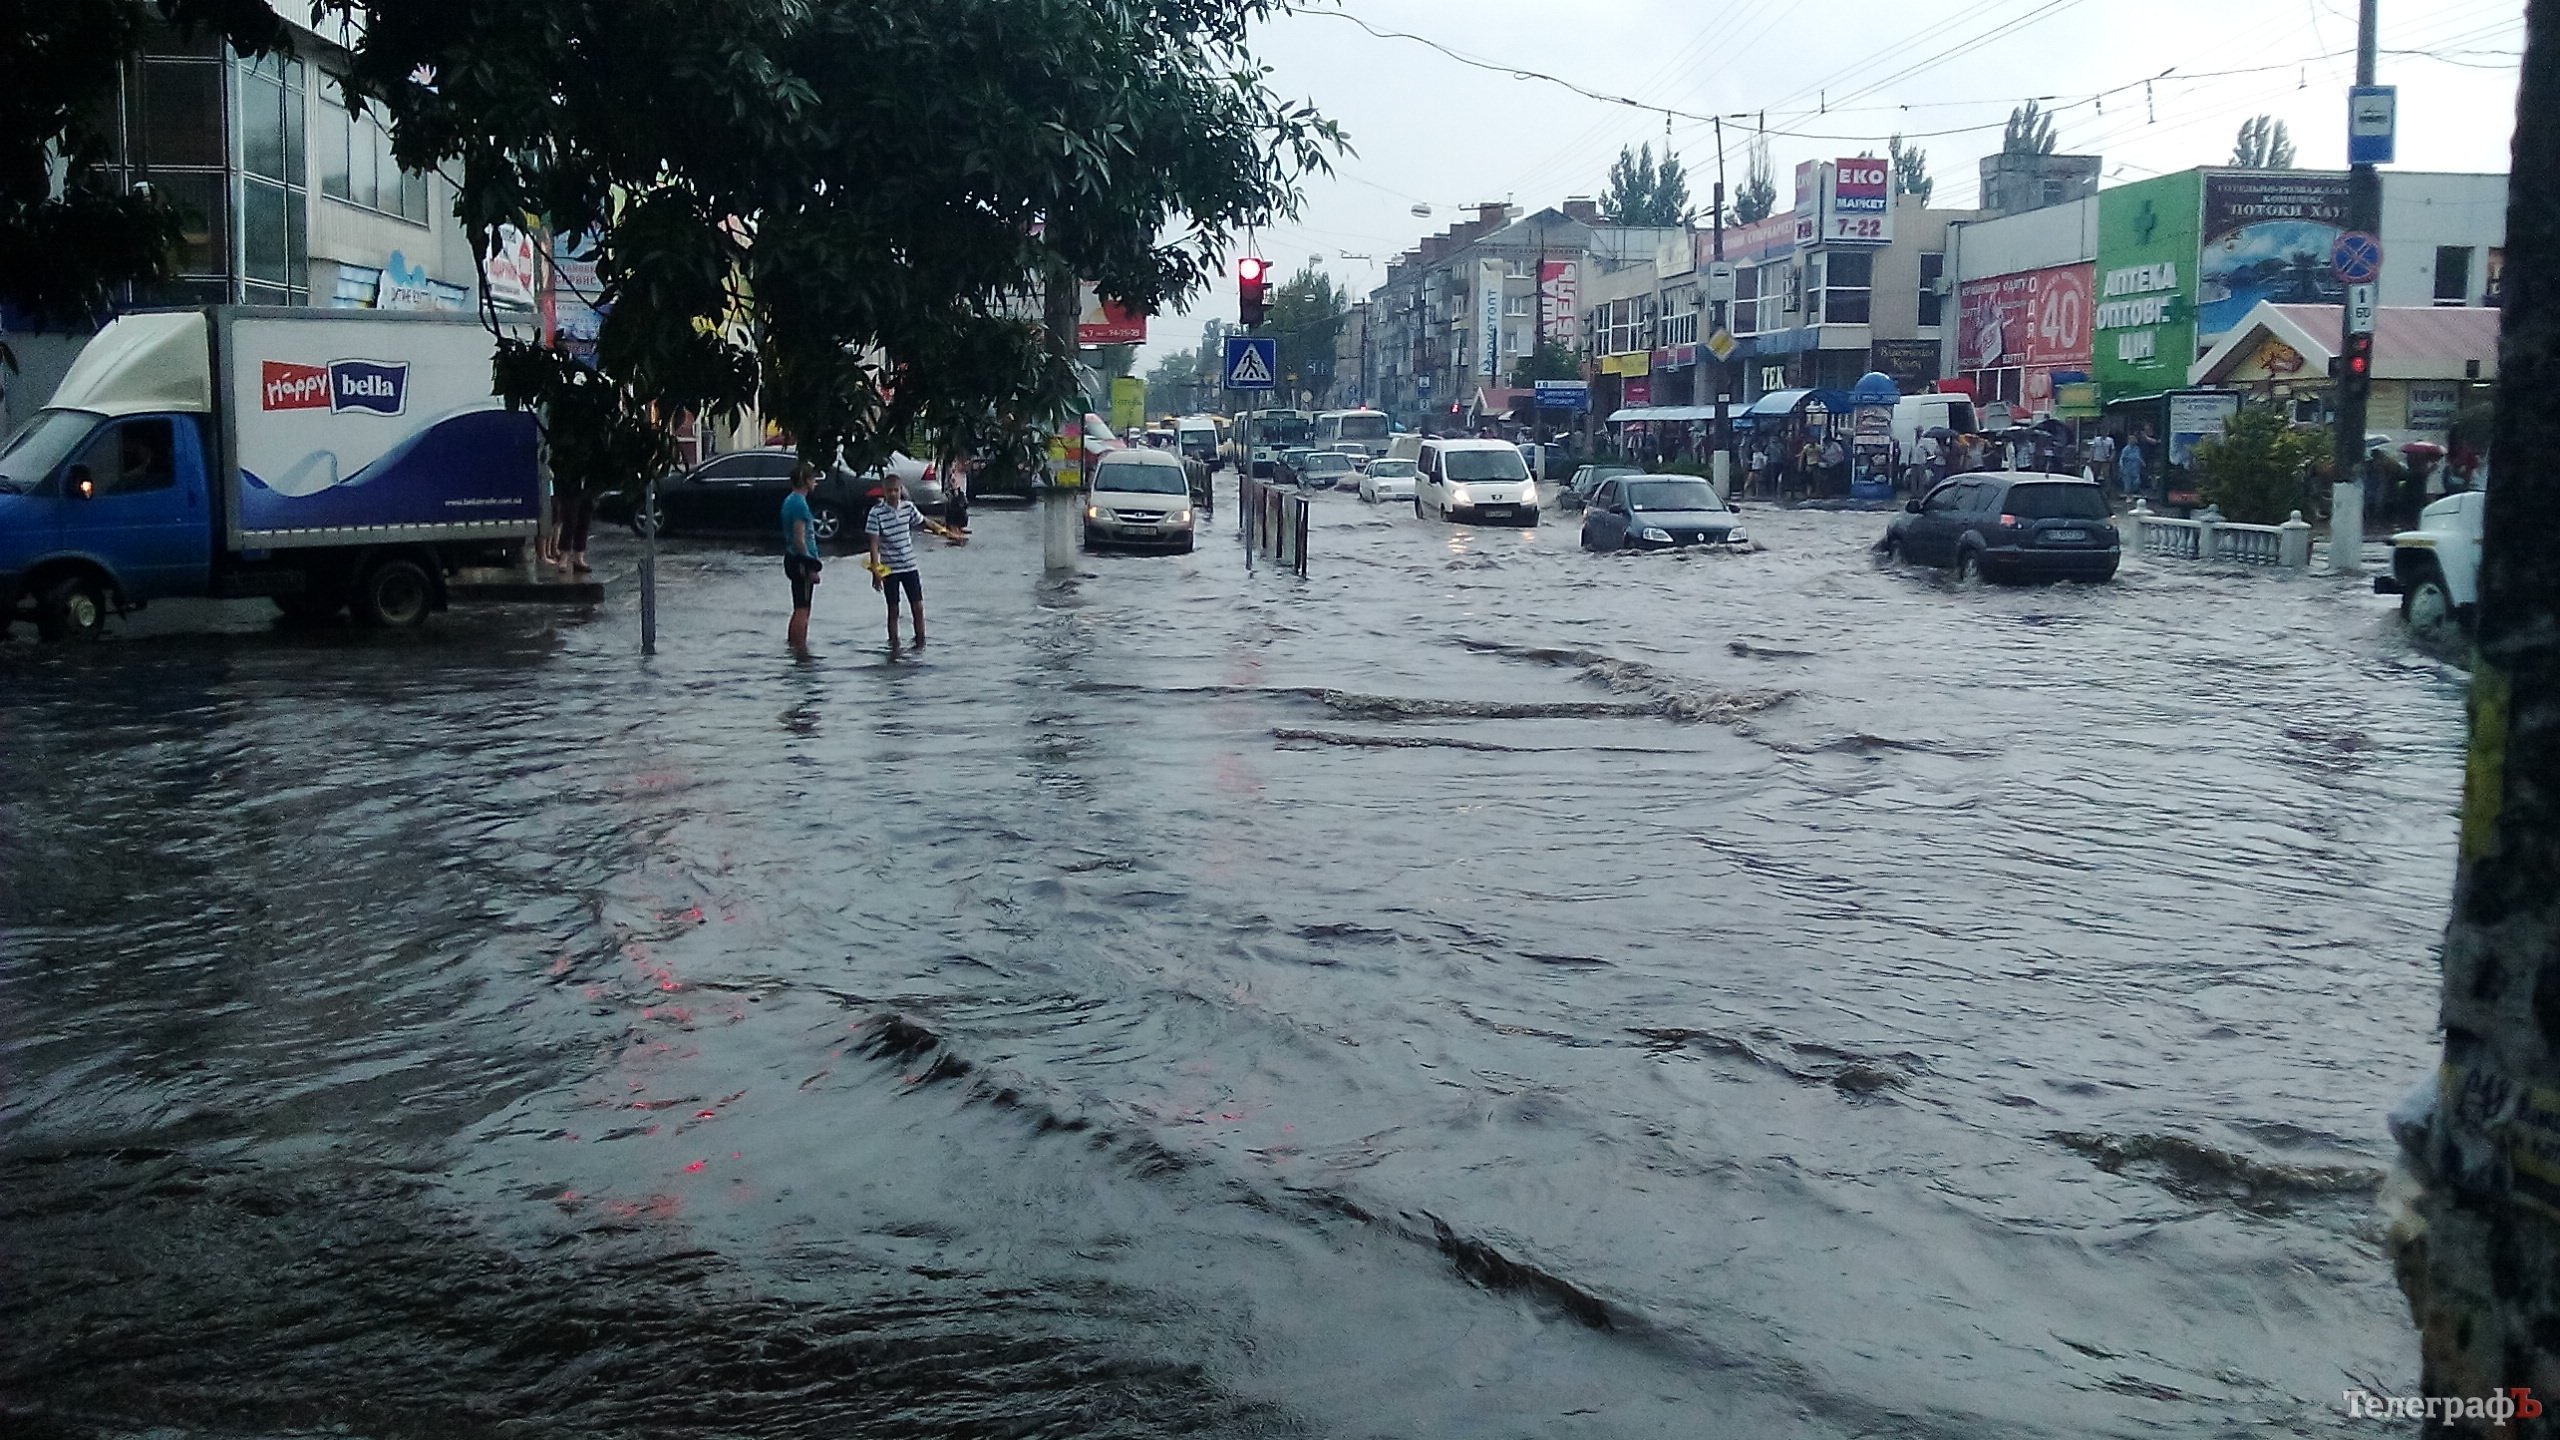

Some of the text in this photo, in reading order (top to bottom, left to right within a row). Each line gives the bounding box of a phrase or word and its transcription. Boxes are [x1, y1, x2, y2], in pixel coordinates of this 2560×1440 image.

[1838, 168, 1885, 185] ЕКО
[1835, 198, 1886, 210] МАРКЕТ
[2231, 204, 2302, 217] ПОТОКИ
[1837, 218, 1882, 237] 7-22
[2103, 262, 2177, 297] АПТЕКА
[2041, 288, 2081, 349] 40
[341, 373, 395, 397] bella
